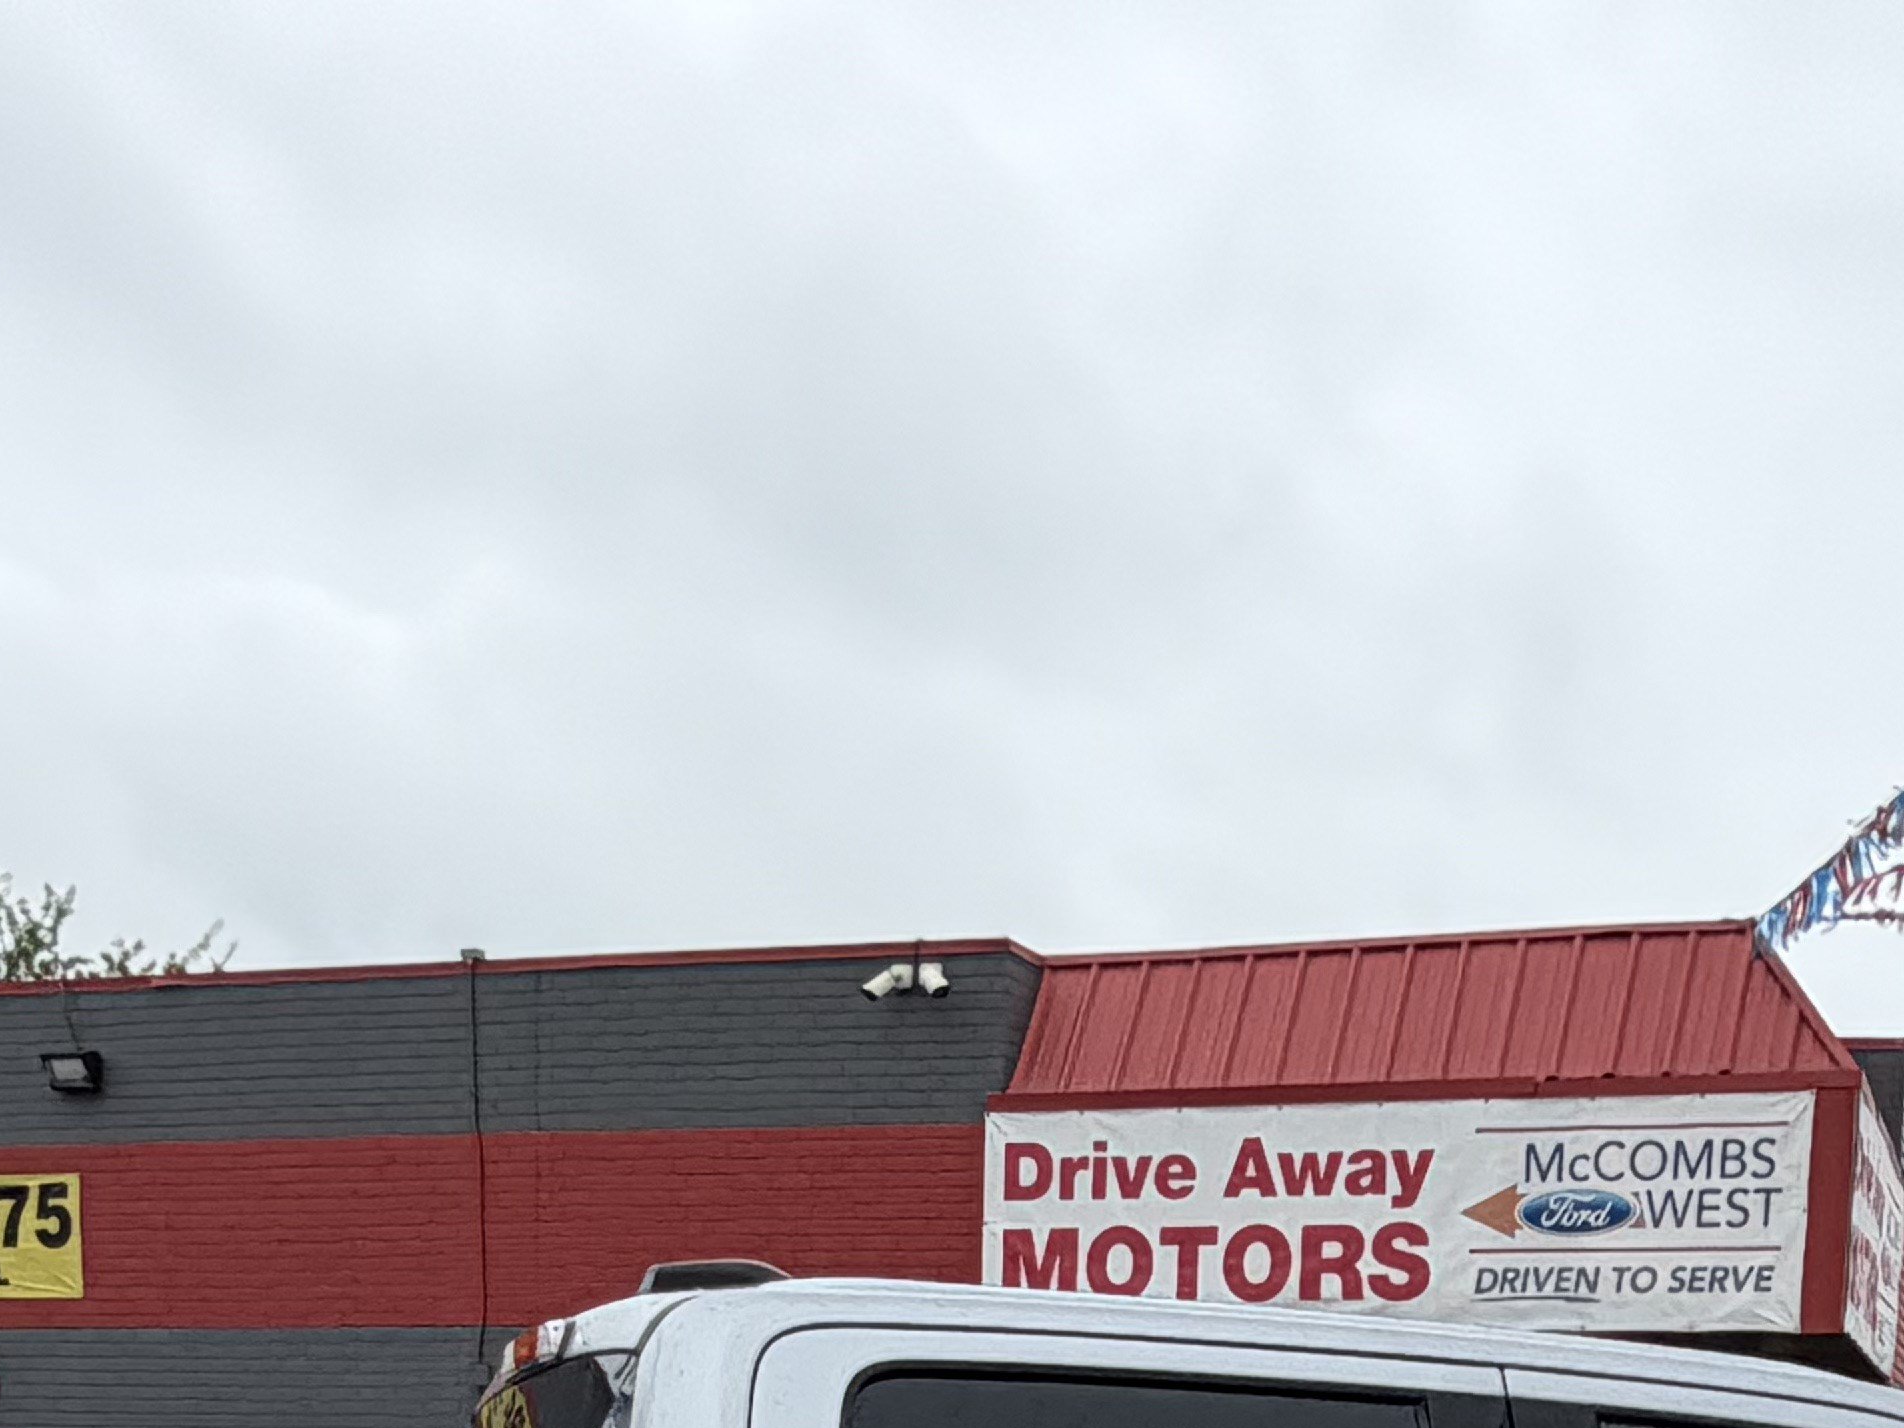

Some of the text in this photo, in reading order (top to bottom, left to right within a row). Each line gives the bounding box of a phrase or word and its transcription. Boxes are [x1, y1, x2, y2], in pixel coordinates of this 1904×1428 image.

[1004, 1136, 1435, 1209] Drive Away
[1524, 1137, 1777, 1184] McCOMBS
[1540, 1192, 1614, 1228] Ford
[1646, 1188, 1783, 1228] WEST
[1002, 1221, 1432, 1303] MOTORS
[1473, 1265, 1776, 1294] DRIVEN TO SERVE
